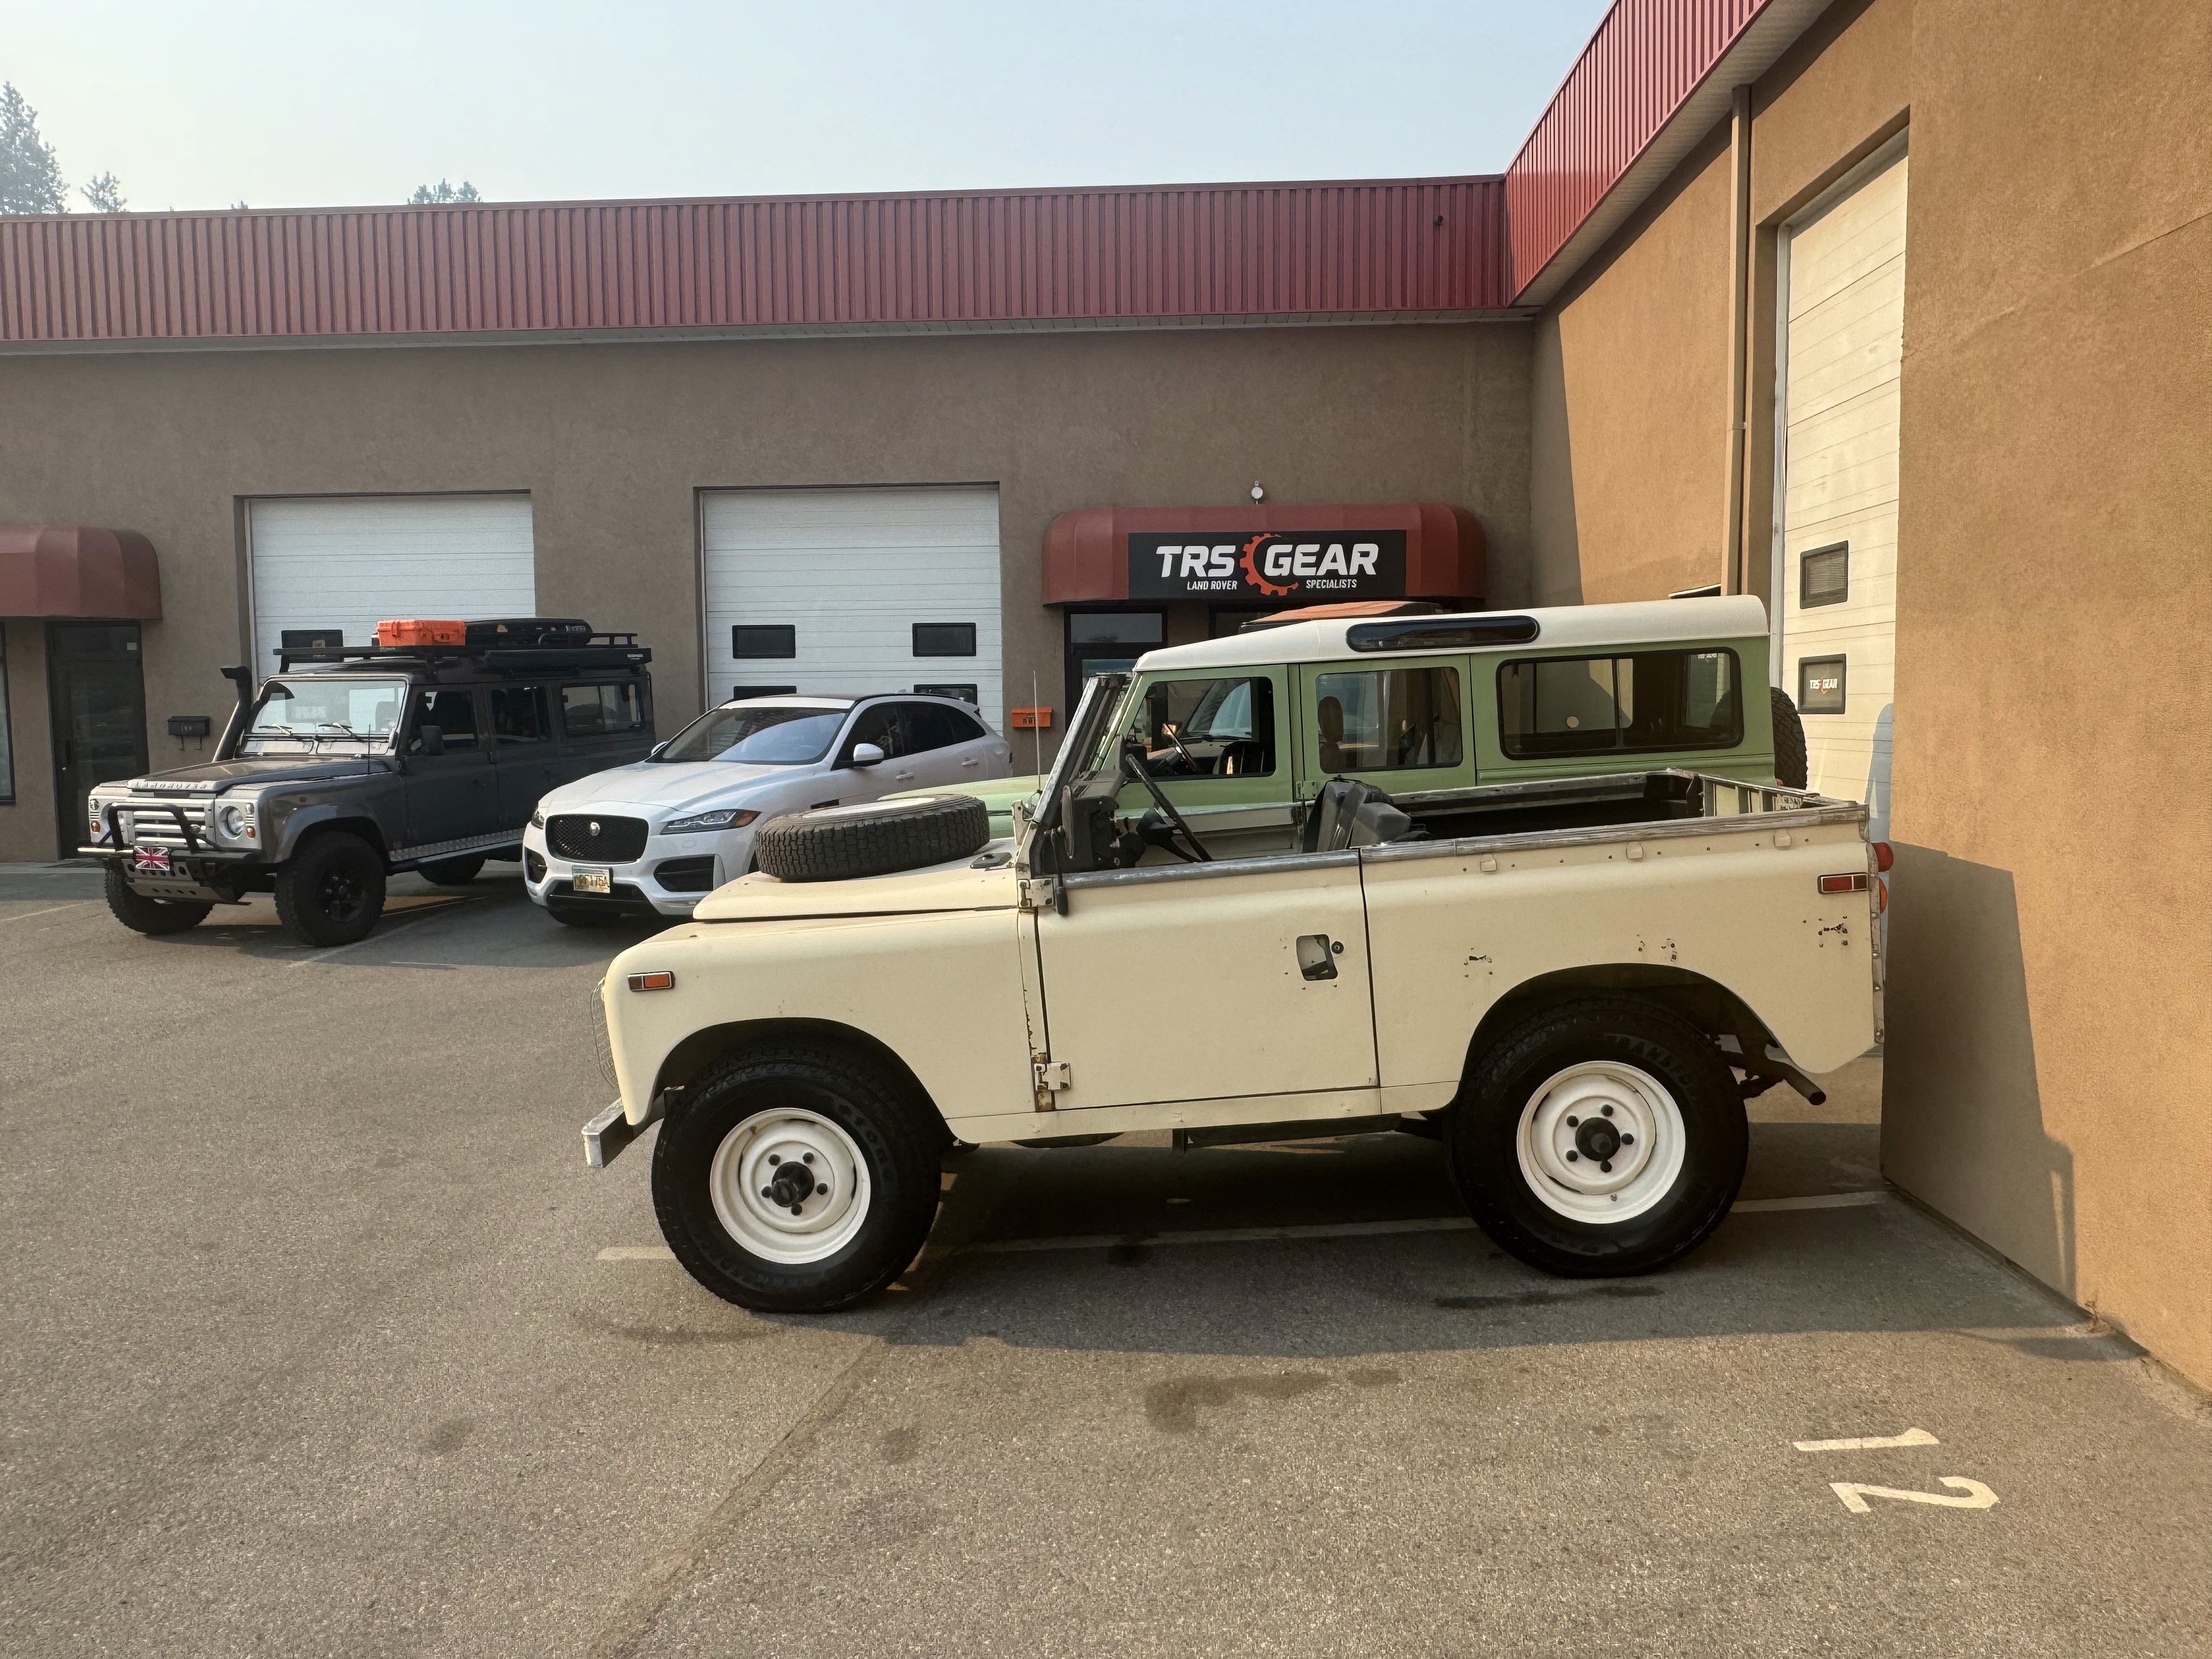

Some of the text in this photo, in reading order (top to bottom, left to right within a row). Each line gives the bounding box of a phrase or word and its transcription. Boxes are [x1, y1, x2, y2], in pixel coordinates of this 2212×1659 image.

[1156, 543, 1379, 578] TRS GEAR
[1187, 579, 1357, 590] LAND ROVER SPECIALISTS
[1792, 1427, 2001, 1513] 12
